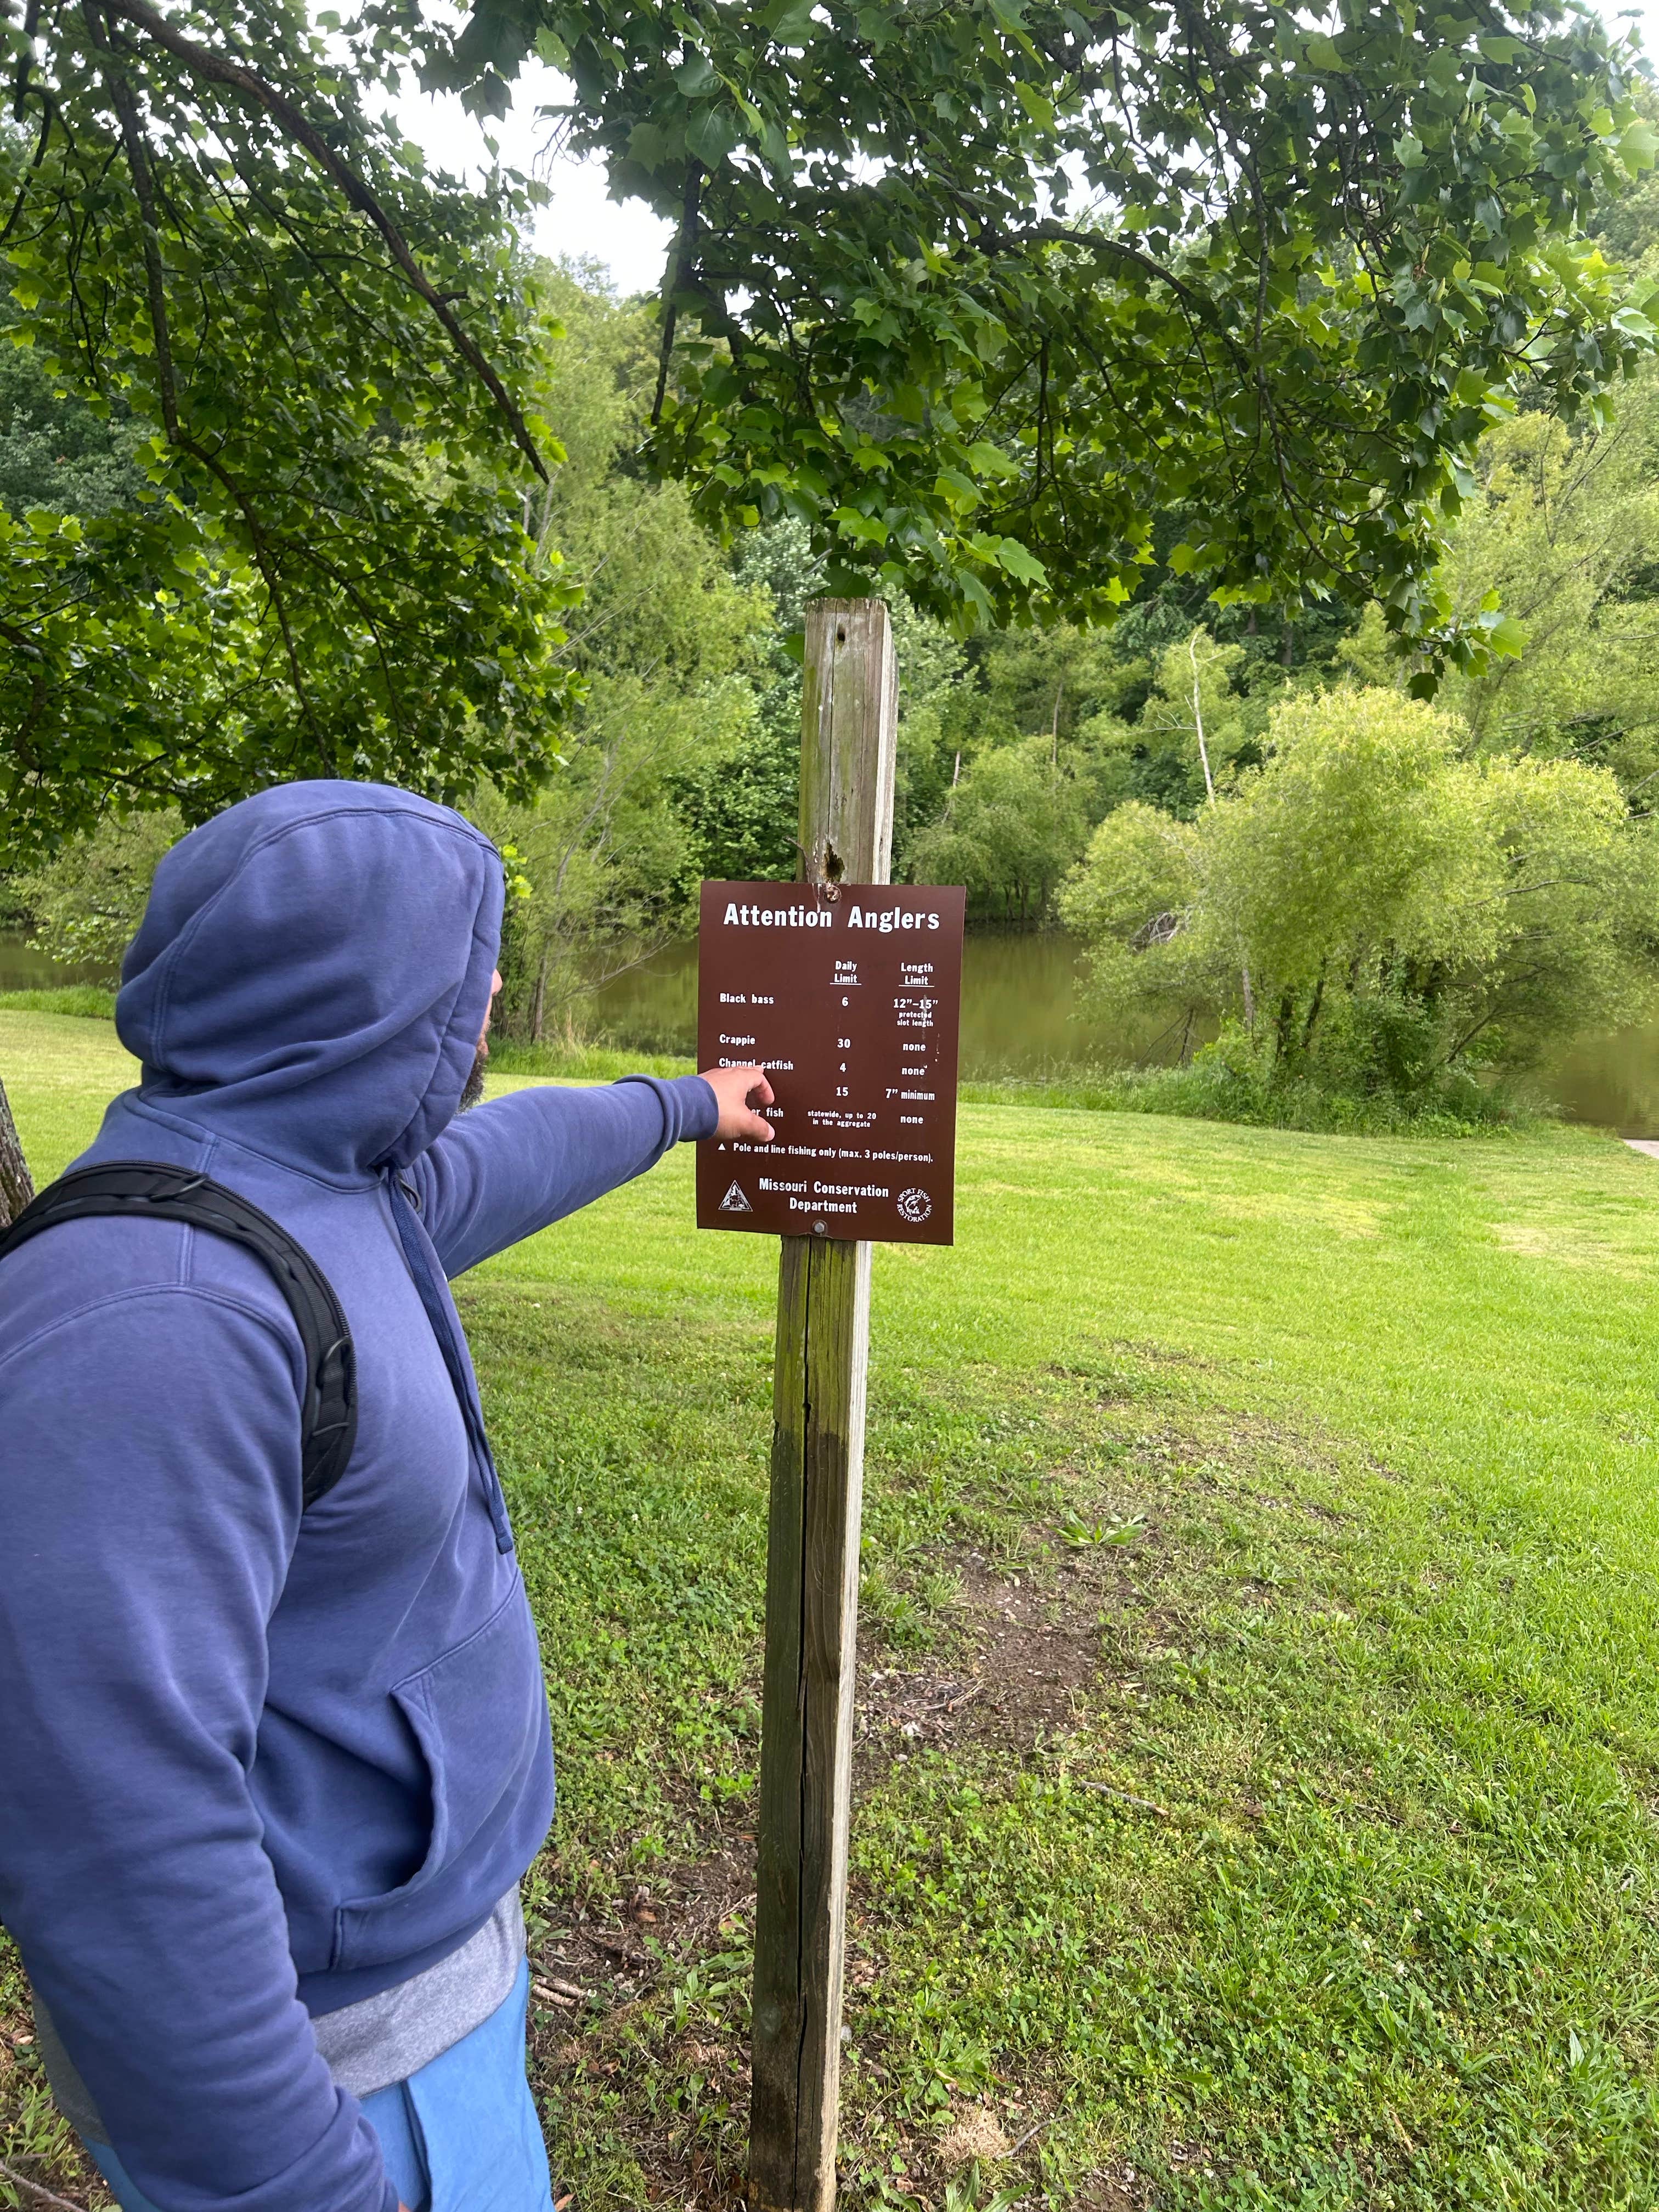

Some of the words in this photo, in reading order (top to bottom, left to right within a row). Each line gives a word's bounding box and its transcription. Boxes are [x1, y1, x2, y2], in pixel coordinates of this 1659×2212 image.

[723, 902, 832, 927] Attention
[847, 906, 940, 933] Anglers
[834, 961, 857, 972] Daily
[901, 962, 933, 973] Length
[834, 973, 857, 983] Limit
[904, 975, 928, 985] Limit
[720, 992, 746, 1003] Black
[752, 994, 774, 1005] bass
[842, 996, 849, 1007] 6
[912, 1019, 934, 1028] length
[719, 1034, 755, 1046] Crappie
[837, 1038, 851, 1048] 30
[902, 1043, 926, 1052] none
[719, 1057, 755, 1068] Channel
[760, 1060, 794, 1070] catfish
[839, 1063, 847, 1073] 4
[901, 1067, 925, 1076] none
[836, 1086, 849, 1097] 15
[901, 1090, 935, 1101] minimum
[766, 1107, 783, 1118] fish
[808, 1110, 842, 1119] statewide,
[837, 1120, 871, 1128] aggregate
[900, 1116, 924, 1124] none
[733, 1142, 752, 1152] Pole
[754, 1144, 769, 1153] and
[771, 1144, 786, 1154] line
[788, 1145, 817, 1157] fishing
[819, 1147, 837, 1158] only
[838, 1148, 862, 1159] (max.
[864, 1149, 870, 1159] 3
[872, 1150, 933, 1164] poles/person).
[759, 1177, 807, 1193] Missouri
[814, 1181, 889, 1198] Conservation
[898, 1188, 916, 1202] SPORT
[917, 1189, 931, 1203] FISH
[789, 1197, 857, 1214] Department
[896, 1204, 932, 1222] RESTORATION
